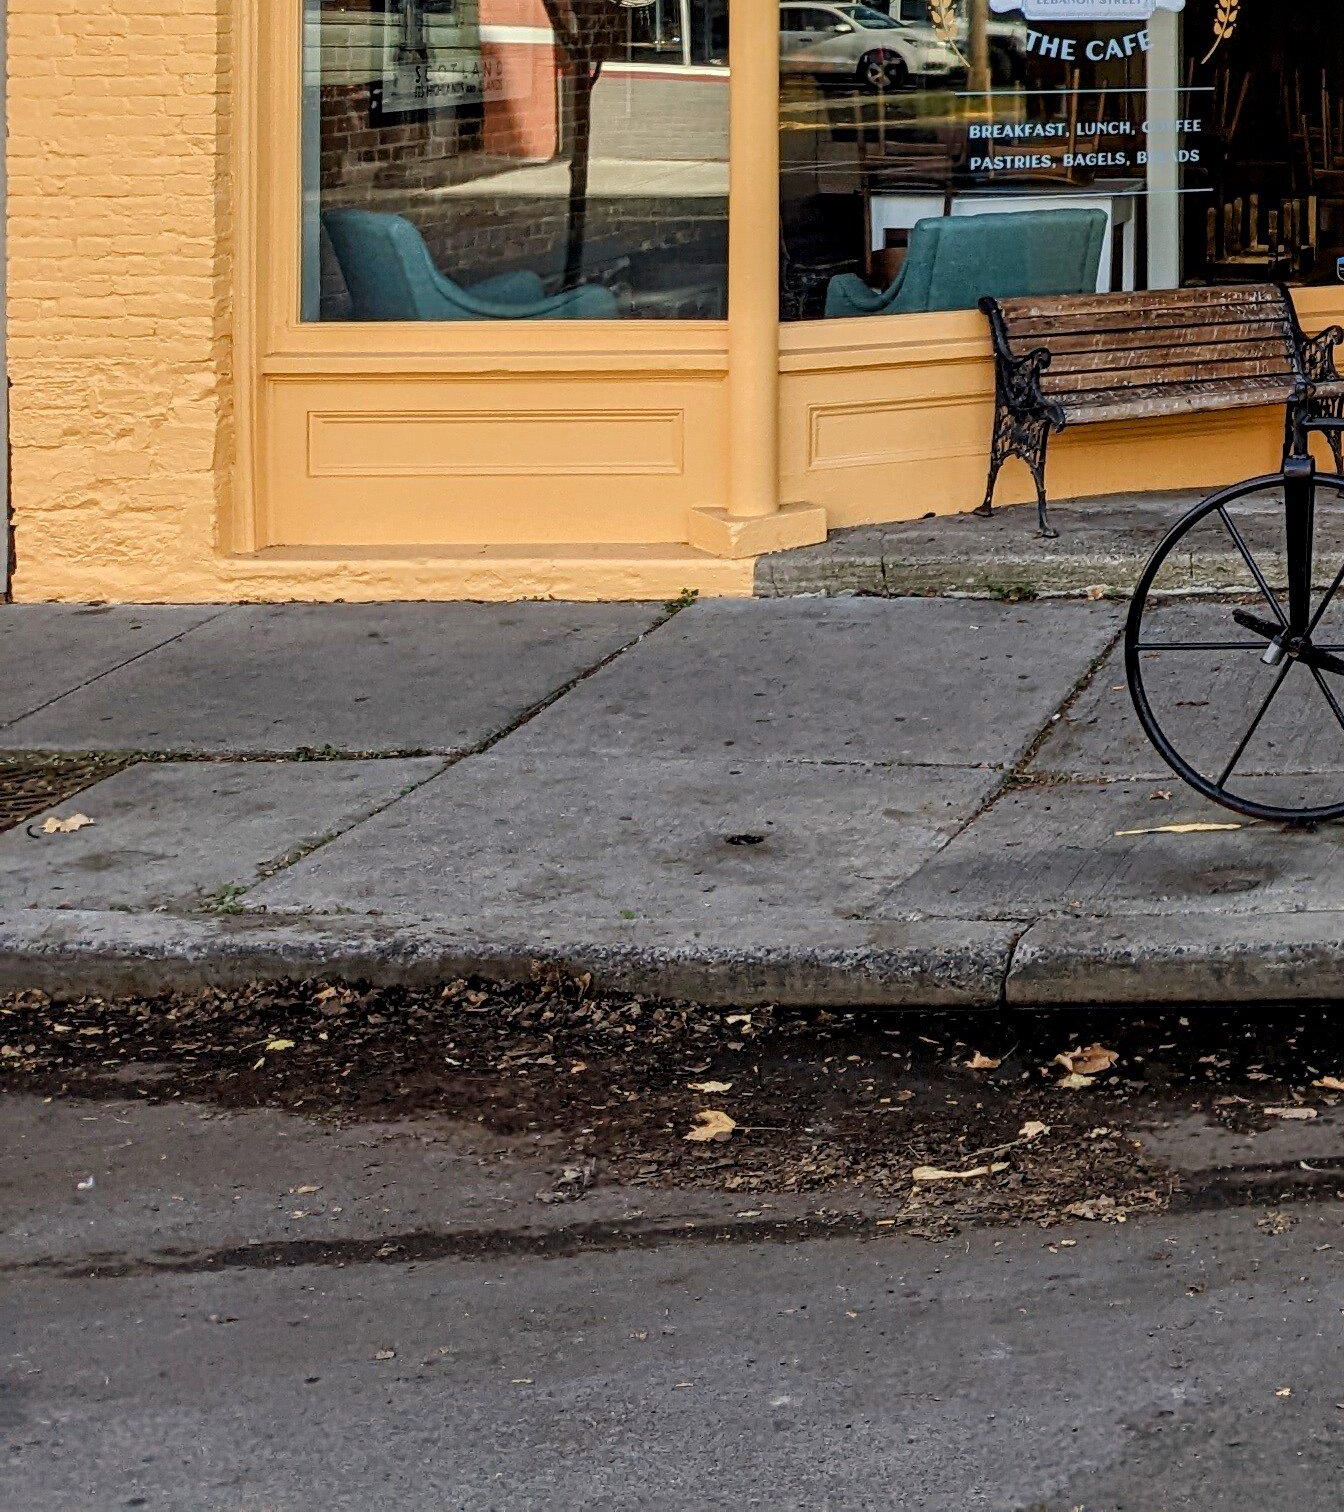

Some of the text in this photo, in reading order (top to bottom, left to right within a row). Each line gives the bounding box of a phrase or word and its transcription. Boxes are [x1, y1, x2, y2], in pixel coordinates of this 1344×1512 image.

[1026, 29, 1153, 61] THE CAFE
[969, 122, 1069, 139] BREAKFAST,
[1076, 121, 1136, 136] LUNCH,
[970, 154, 1057, 170] PASTRIES,
[1063, 152, 1130, 167] BAGELS,
